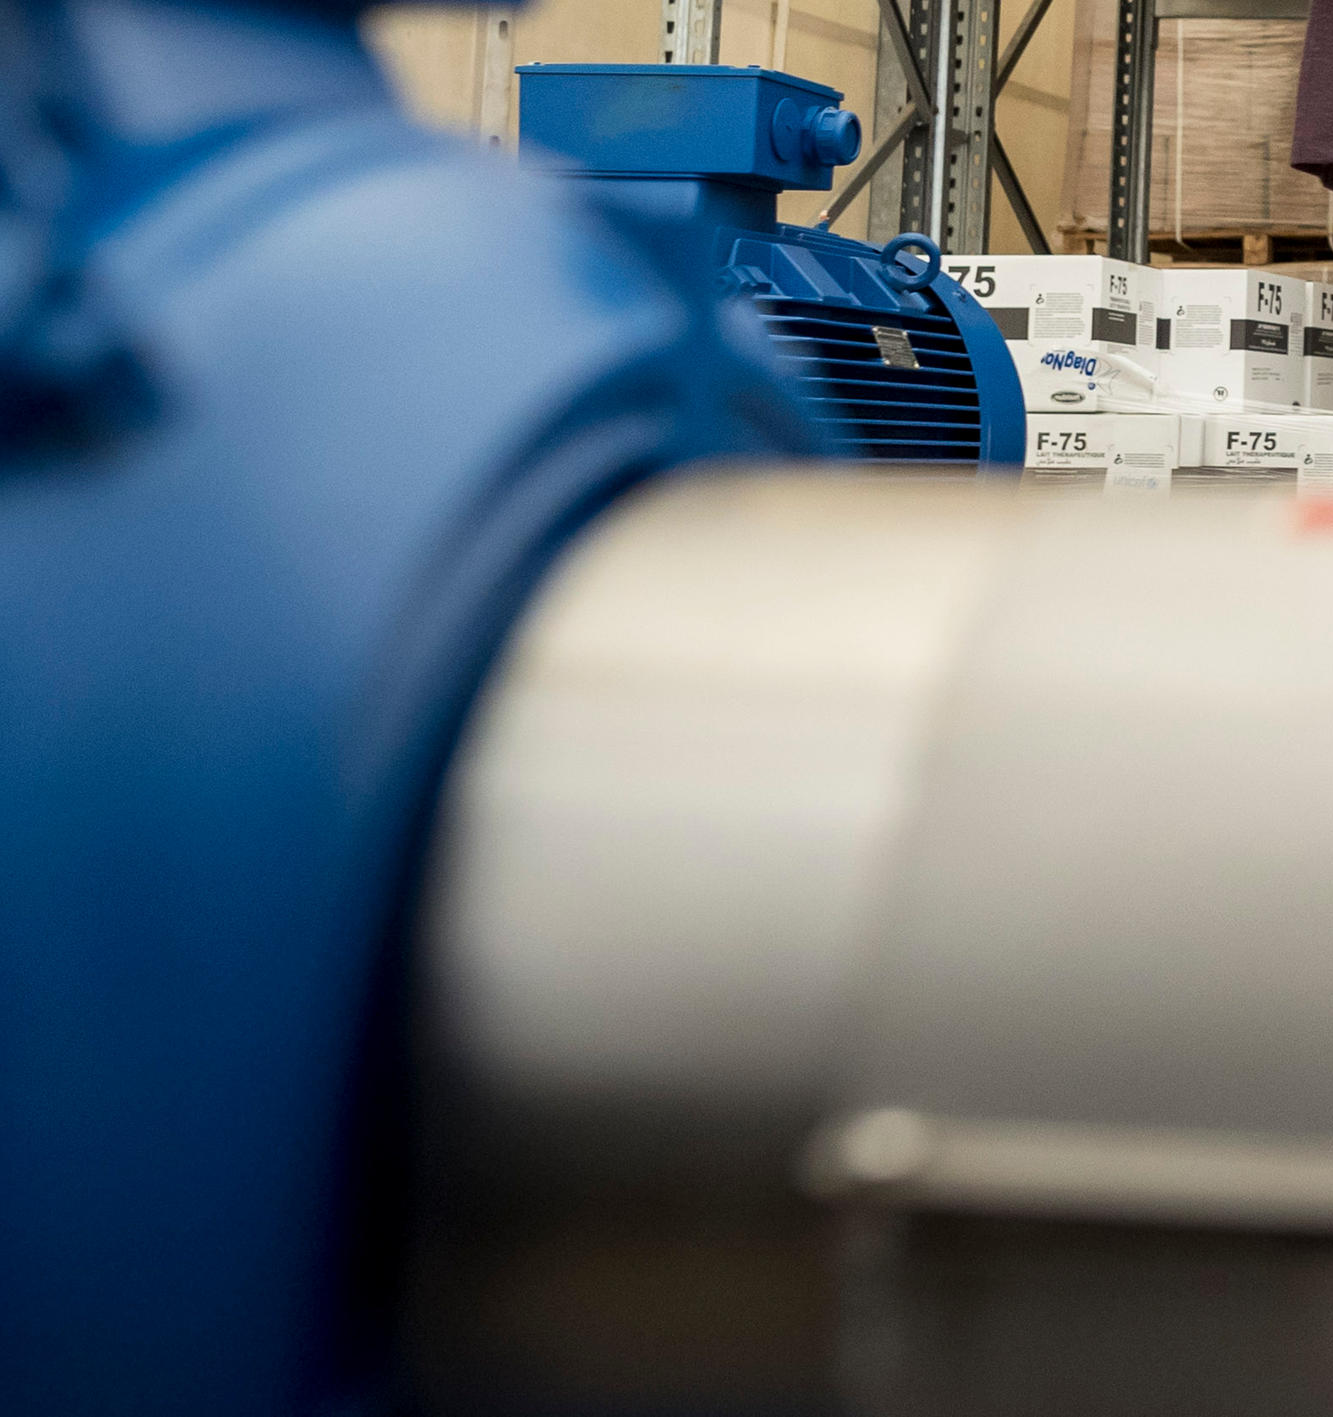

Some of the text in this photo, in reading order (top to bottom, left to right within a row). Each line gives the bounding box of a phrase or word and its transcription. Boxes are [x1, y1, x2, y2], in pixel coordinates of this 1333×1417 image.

[1109, 274, 1128, 296] F-75
[1258, 282, 1283, 316] F-75
[1037, 432, 1087, 451] F-75
[1226, 431, 1277, 451] F-75
